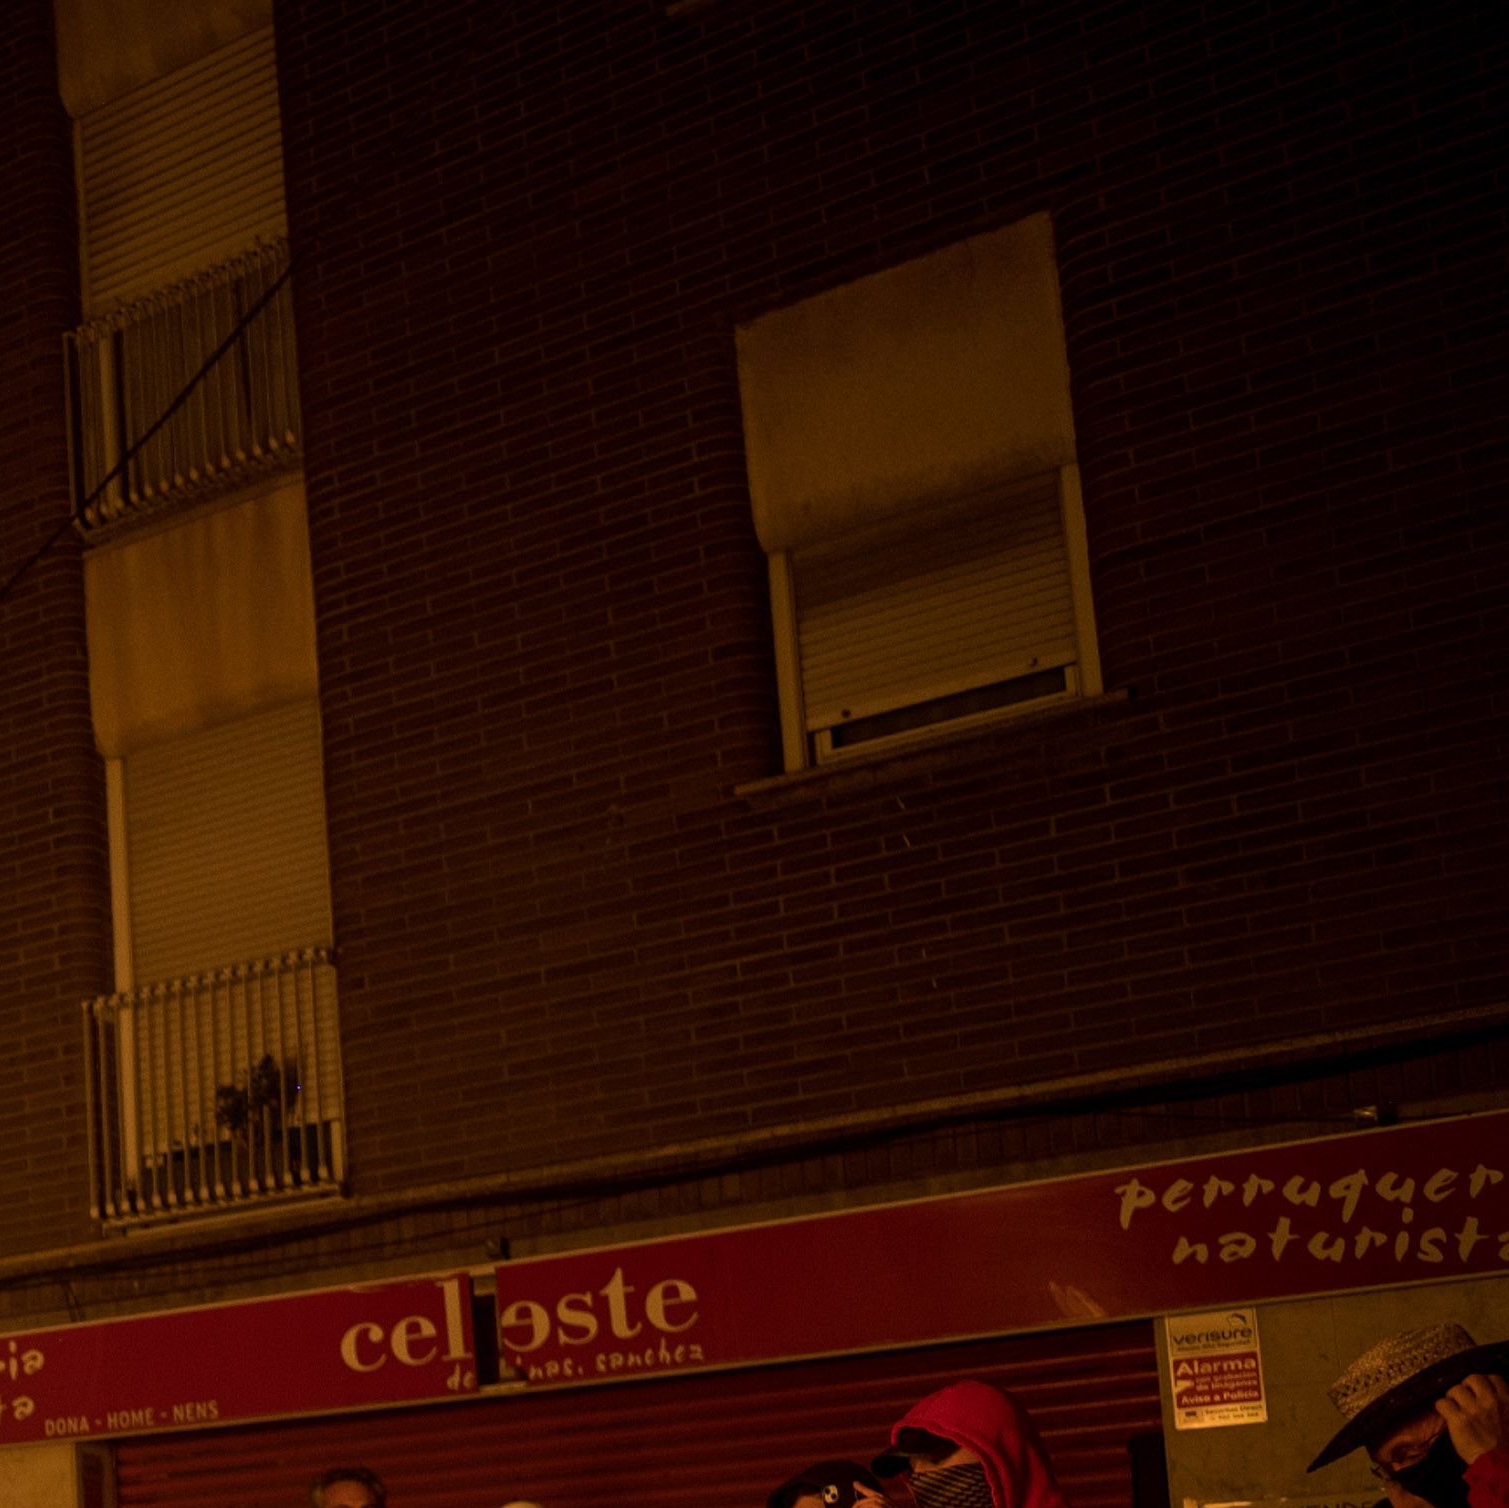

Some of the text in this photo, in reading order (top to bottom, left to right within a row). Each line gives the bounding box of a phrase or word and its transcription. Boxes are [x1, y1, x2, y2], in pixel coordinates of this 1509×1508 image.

[1114, 1163, 1504, 1231] perruquer
[1172, 1328, 1253, 1346] verisure
[1176, 1358, 1257, 1377] Alarma
[44, 1399, 219, 1437] DONA HOME NENS
